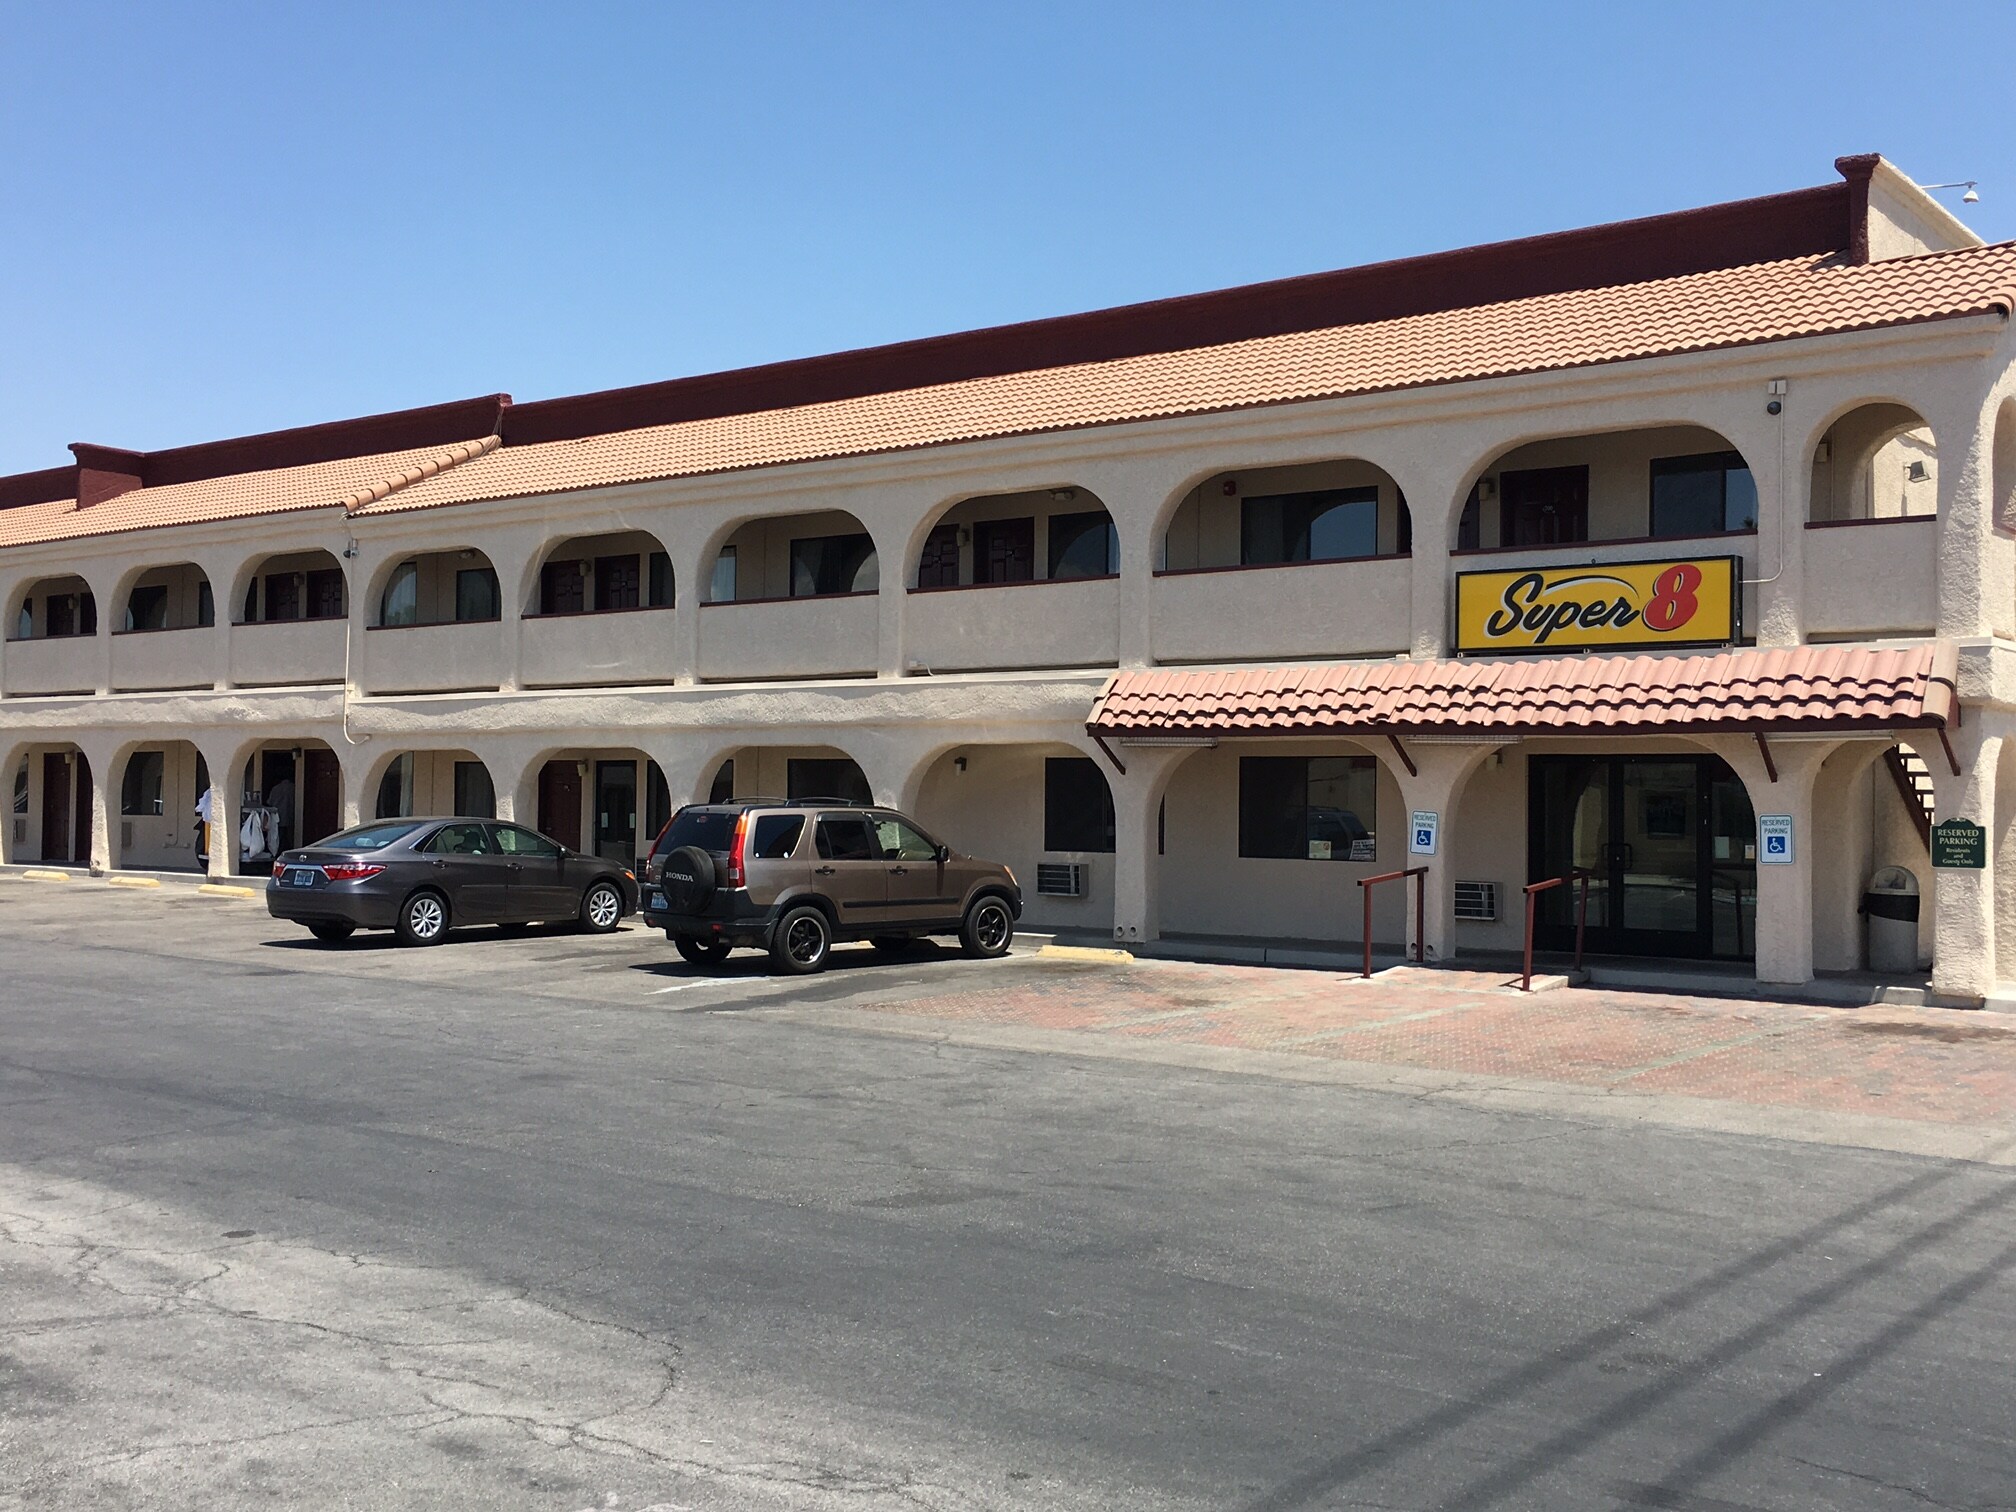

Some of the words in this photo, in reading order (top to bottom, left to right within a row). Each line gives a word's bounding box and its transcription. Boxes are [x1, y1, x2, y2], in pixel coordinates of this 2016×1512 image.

[1486, 573, 1640, 644] Super
[1642, 564, 1702, 632] 8
[1937, 829, 1979, 837] RESERVED
[1939, 837, 1978, 846] PARKING
[665, 871, 694, 882] HONDA
